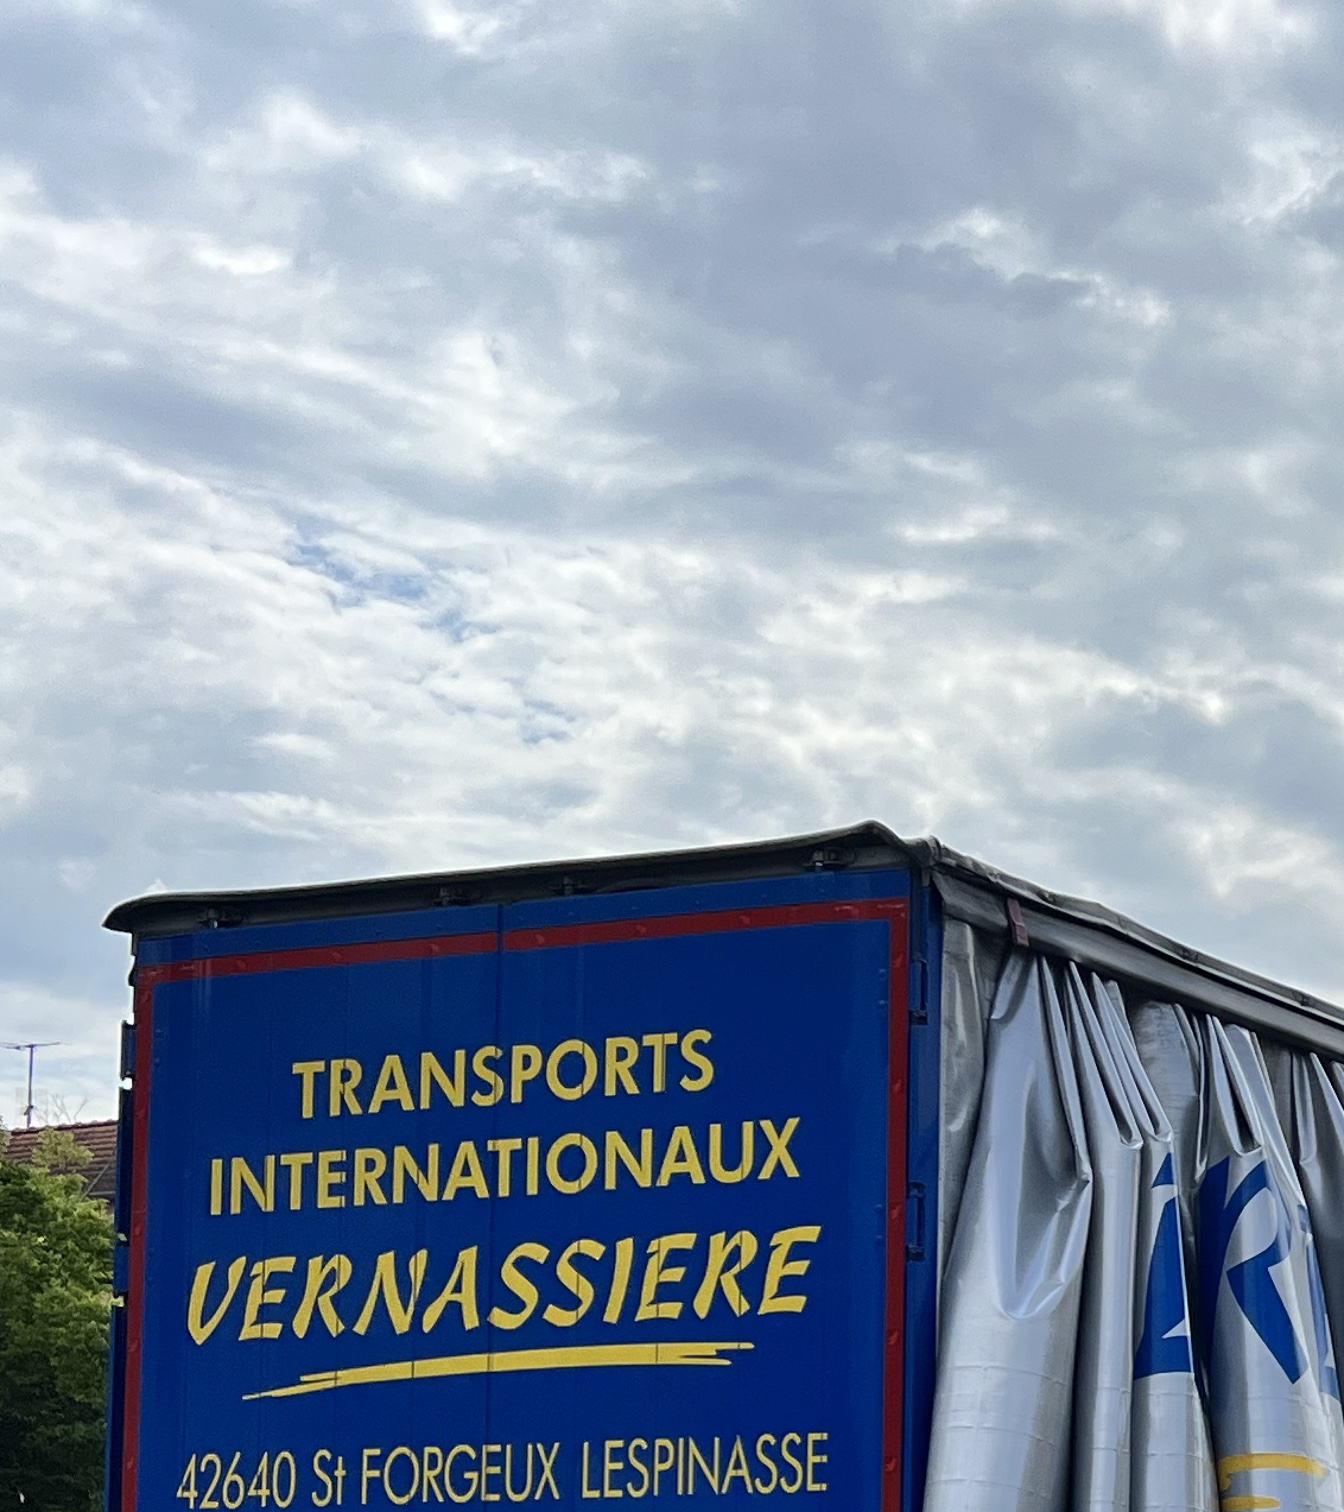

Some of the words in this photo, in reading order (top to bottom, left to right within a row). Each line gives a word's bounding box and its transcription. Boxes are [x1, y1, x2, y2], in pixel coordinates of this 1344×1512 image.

[292, 1028, 716, 1119] TRANSPORTS
[210, 1116, 801, 1216] INTERNATIONAUX
[186, 1225, 822, 1347] VERNASSIERE
[176, 1450, 297, 1510] 42640
[311, 1448, 347, 1508] St
[360, 1441, 560, 1506] FORGEUX
[581, 1431, 829, 1500] LESPINASSE
